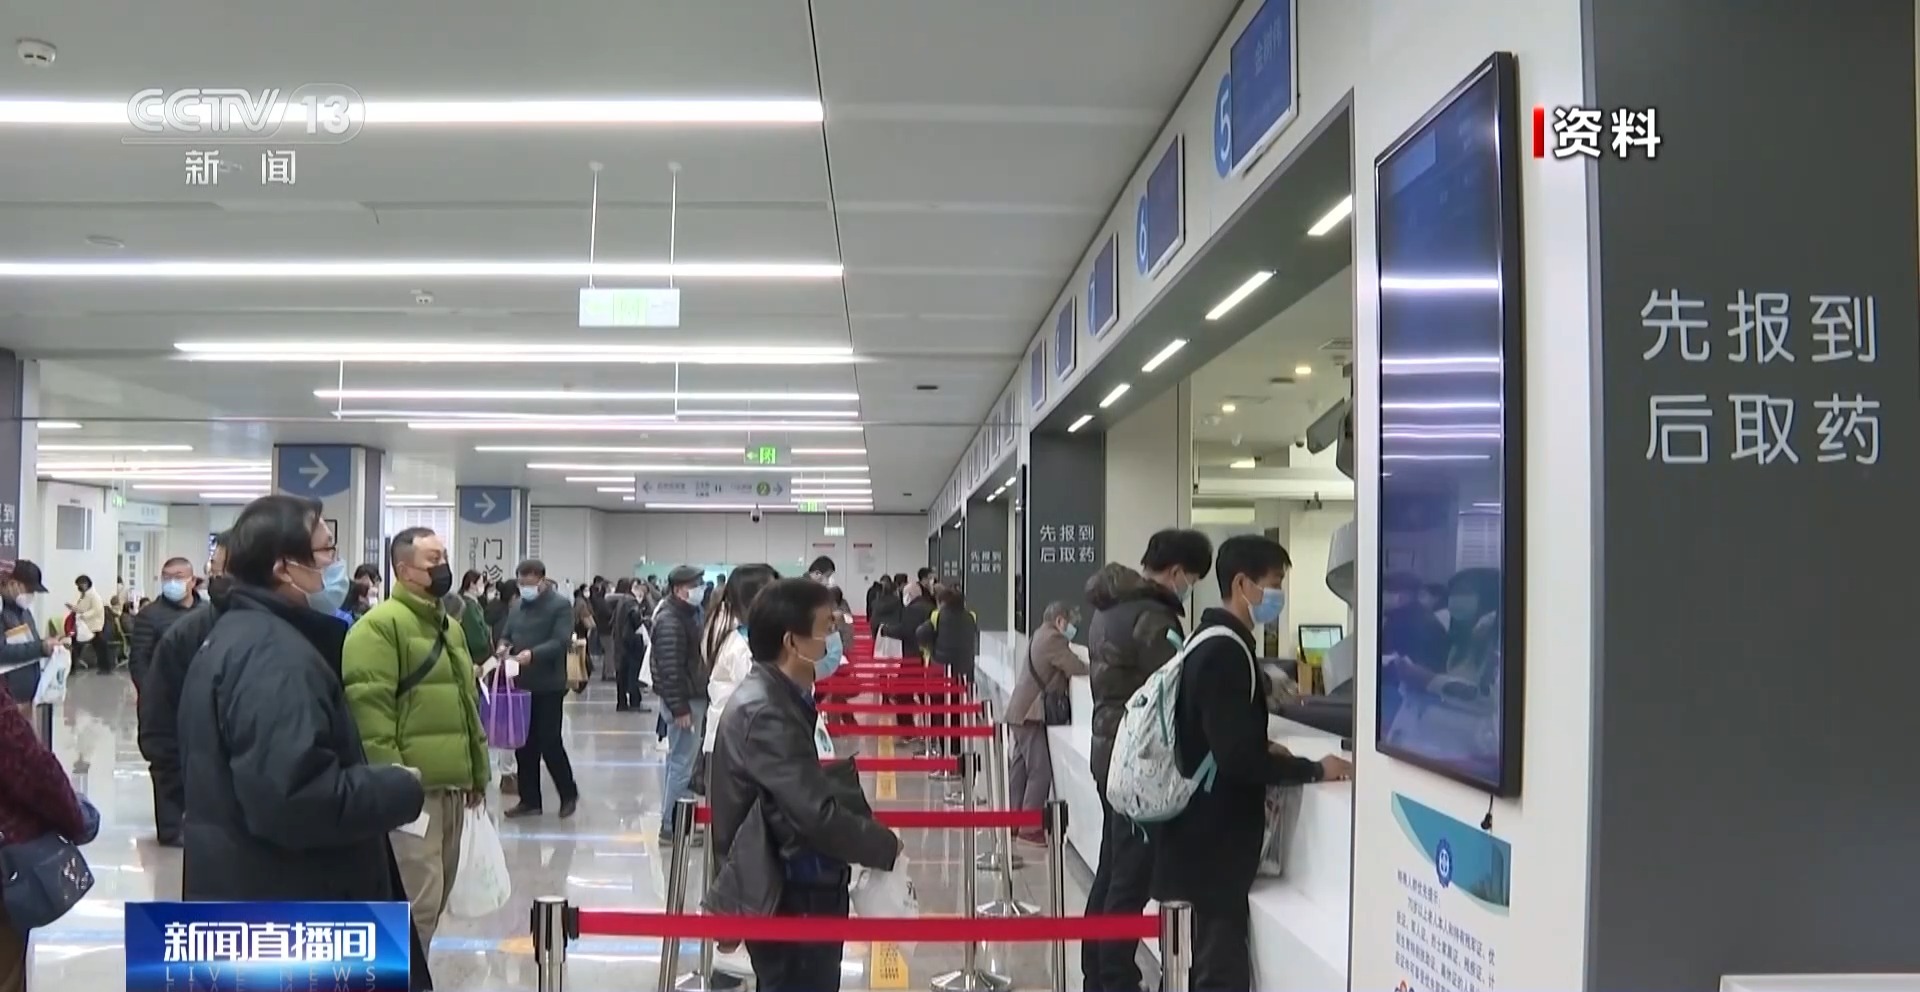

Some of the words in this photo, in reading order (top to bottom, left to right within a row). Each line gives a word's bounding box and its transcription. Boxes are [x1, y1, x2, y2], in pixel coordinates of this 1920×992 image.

[1220, 89, 1231, 162] 5
[1138, 208, 1147, 262] 6
[1641, 289, 1876, 363] 先报到
[1646, 393, 1881, 465] 后取药
[0, 503, 16, 522] 到
[0, 528, 16, 546] 药
[1040, 524, 1095, 542] 先报到
[1040, 546, 1095, 563] 后取药
